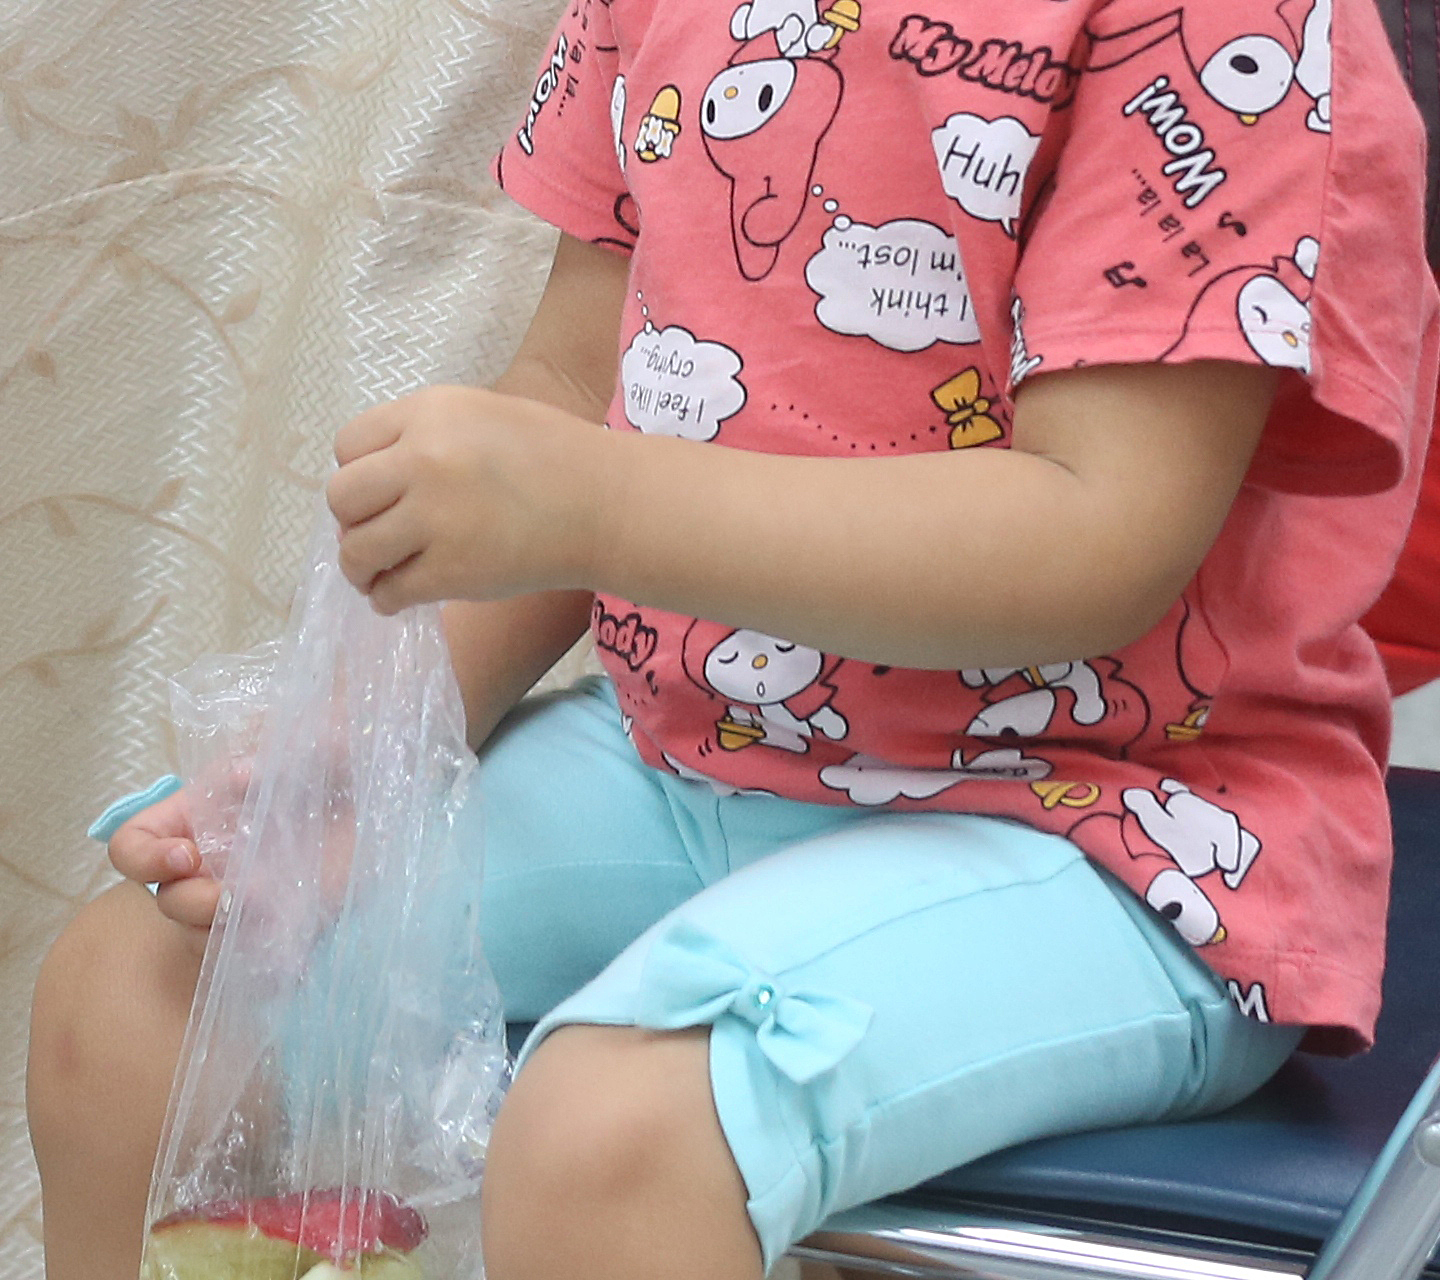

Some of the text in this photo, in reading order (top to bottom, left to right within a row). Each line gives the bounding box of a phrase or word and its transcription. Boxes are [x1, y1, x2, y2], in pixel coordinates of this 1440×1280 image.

[889, 13, 1077, 112] My Melo
[942, 134, 1021, 197] Huh
[931, 251, 963, 282] 'm
[869, 287, 968, 322] I think
[630, 382, 705, 425] I feel like
[590, 599, 659, 672] lody
